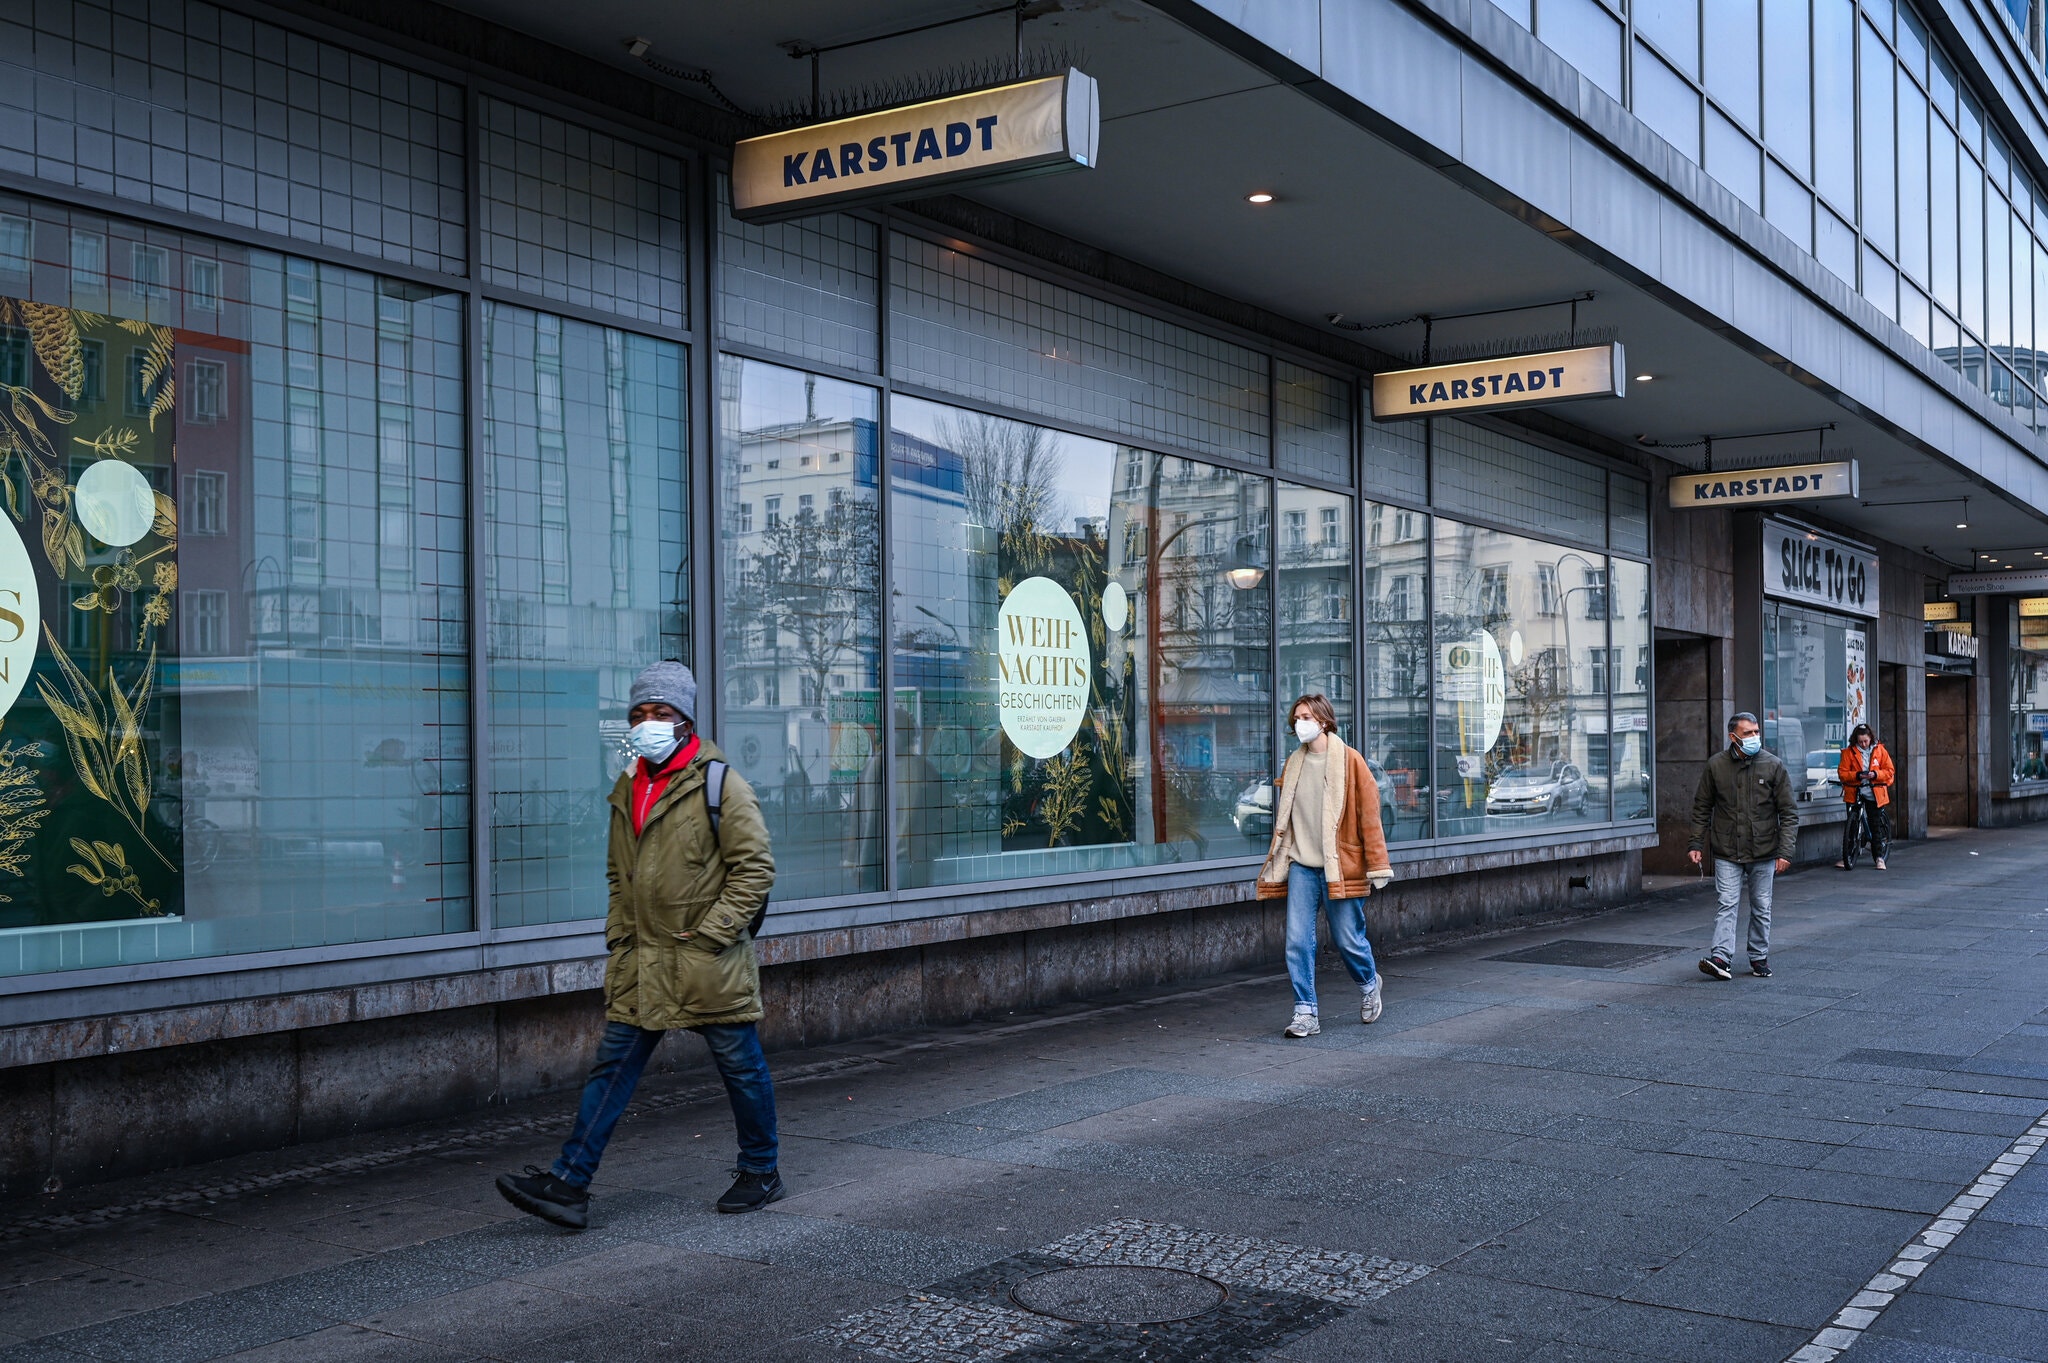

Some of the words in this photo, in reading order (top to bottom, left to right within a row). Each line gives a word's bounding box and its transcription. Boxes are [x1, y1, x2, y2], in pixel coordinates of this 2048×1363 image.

[783, 115, 998, 187] KARSTADT
[1409, 367, 1564, 405] KARSTADT
[1694, 473, 1823, 500] KARSTADT
[1824, 548, 1844, 603] TO
[1847, 555, 1866, 609] GO
[1958, 584, 1986, 593] Telekom
[1986, 583, 2005, 592] Shop
[1948, 631, 1979, 659] KARSTADT
[999, 653, 1087, 688] NACHTS
[1000, 692, 1082, 710] GESCHICHTEN
[1020, 724, 1042, 732] KARSTADT
[1043, 724, 1063, 732] KAUFHOF
